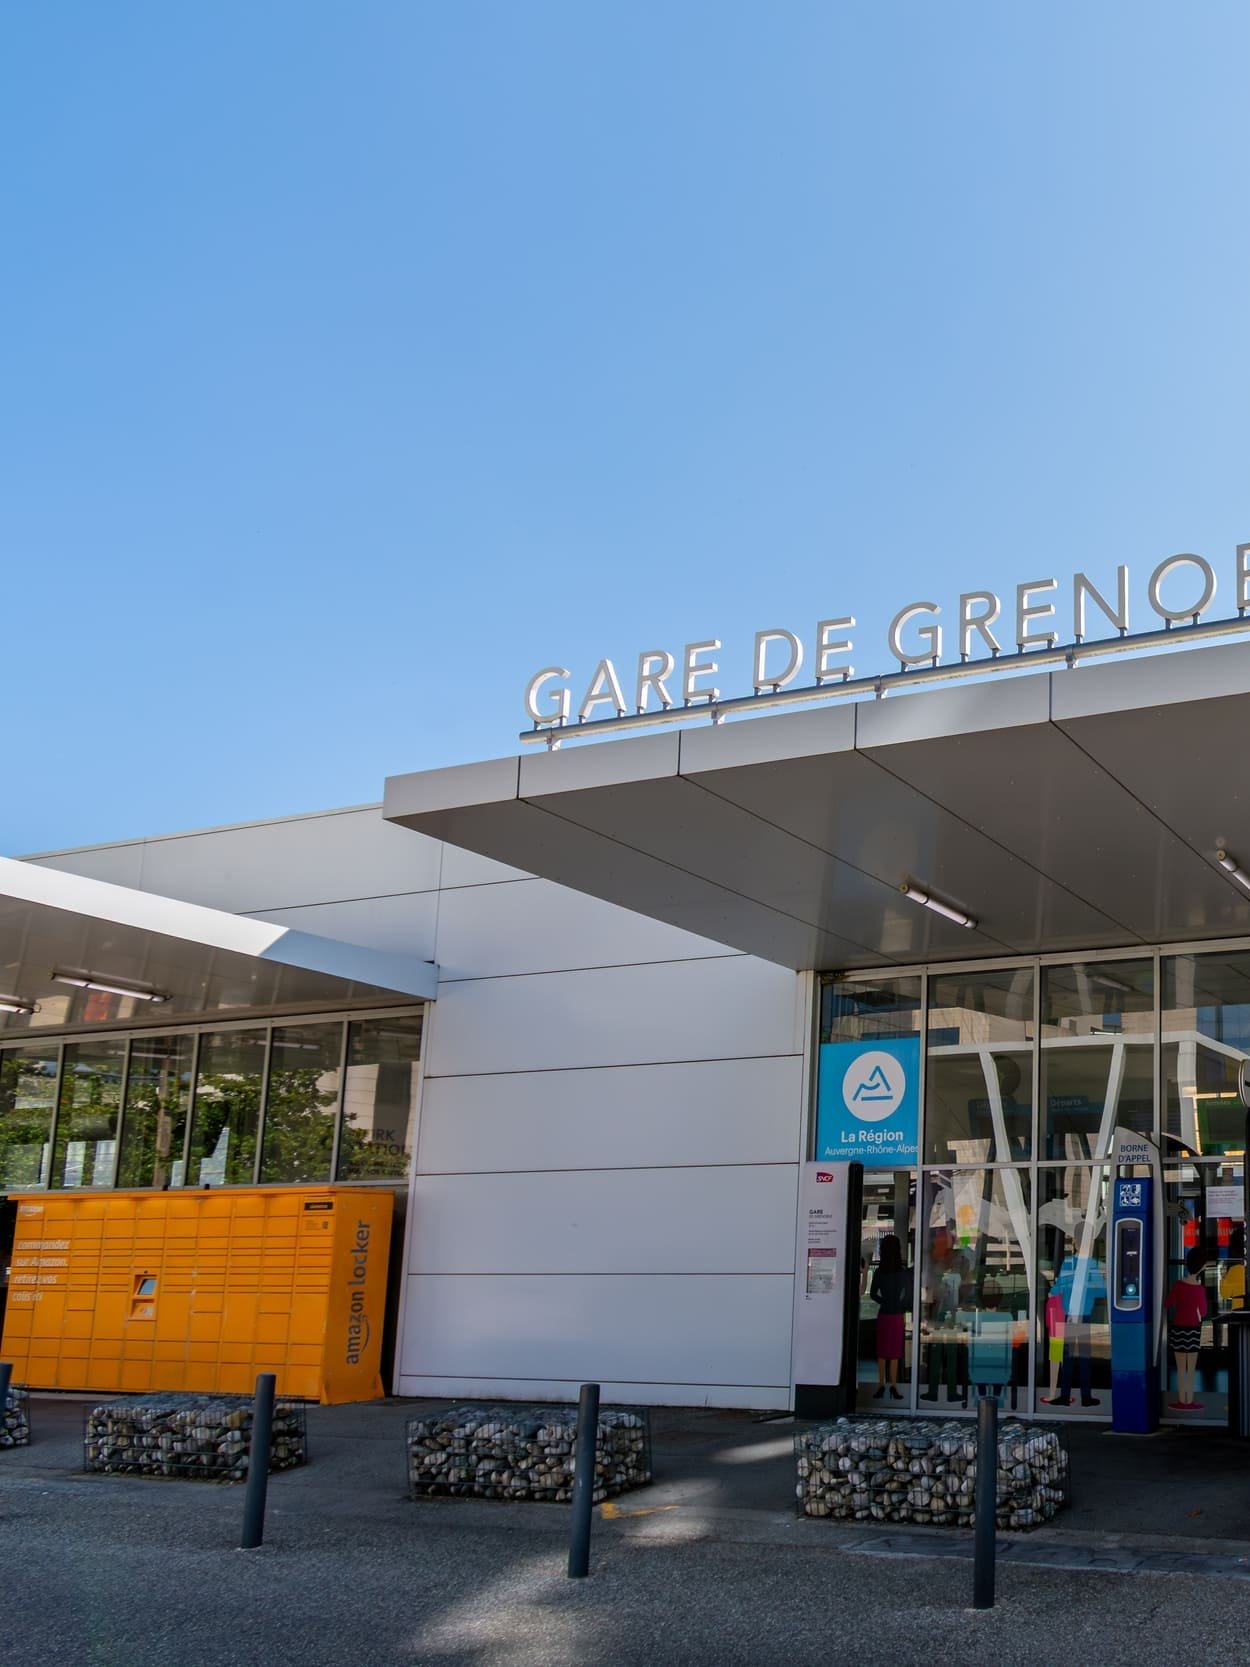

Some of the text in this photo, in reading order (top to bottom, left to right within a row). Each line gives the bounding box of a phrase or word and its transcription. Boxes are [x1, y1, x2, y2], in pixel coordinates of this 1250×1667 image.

[524, 639, 722, 725] GARE
[753, 616, 857, 690] DE
[841, 1129, 904, 1144] La Région
[824, 1144, 920, 1157] Auvergne-Rhône-Alpes
[1120, 1144, 1149, 1153] BORNE
[1118, 1154, 1151, 1163] D'APPEL
[16, 1240, 71, 1250] commandez
[346, 1220, 371, 1365] amazon locker
